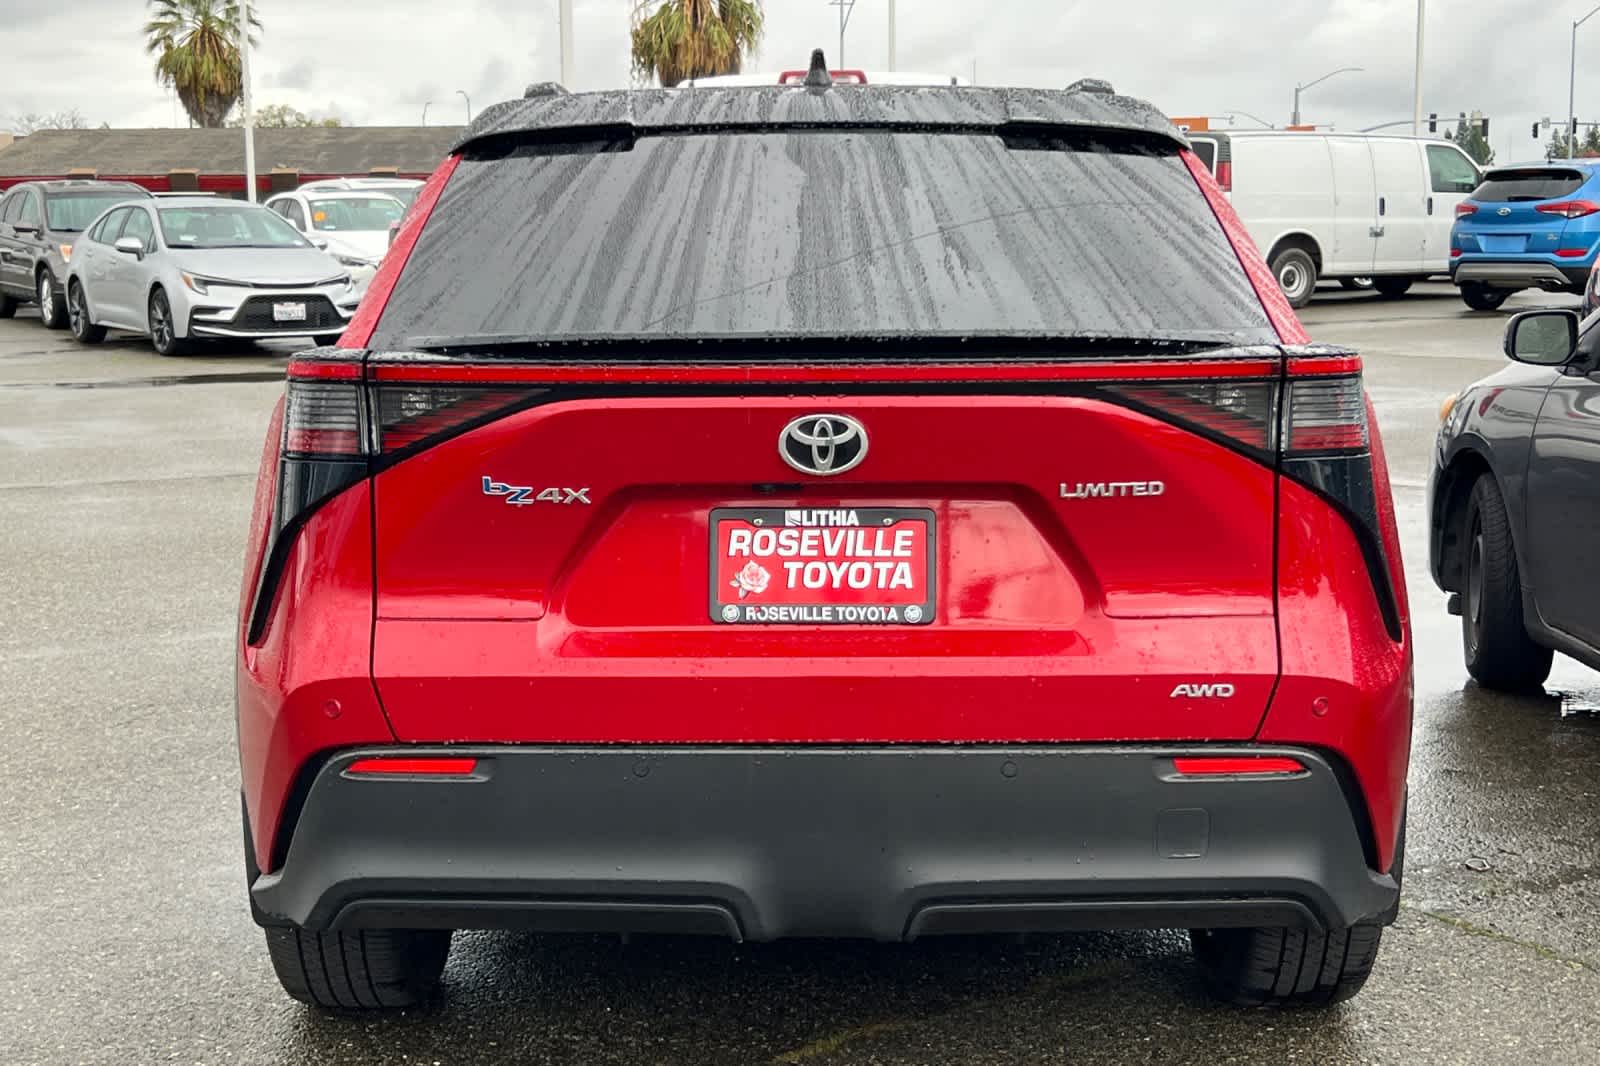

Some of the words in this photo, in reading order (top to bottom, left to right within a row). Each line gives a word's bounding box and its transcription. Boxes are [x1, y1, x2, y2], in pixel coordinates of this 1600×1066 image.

[1060, 481, 1164, 498] LIMITED
[802, 510, 859, 526] LITHIA
[728, 529, 914, 557] ROSEVILLE
[784, 561, 913, 589] TOYOTA
[746, 606, 832, 621] ROSEVILLE
[836, 606, 898, 621] TOYOTA
[1169, 684, 1235, 698] AWD
